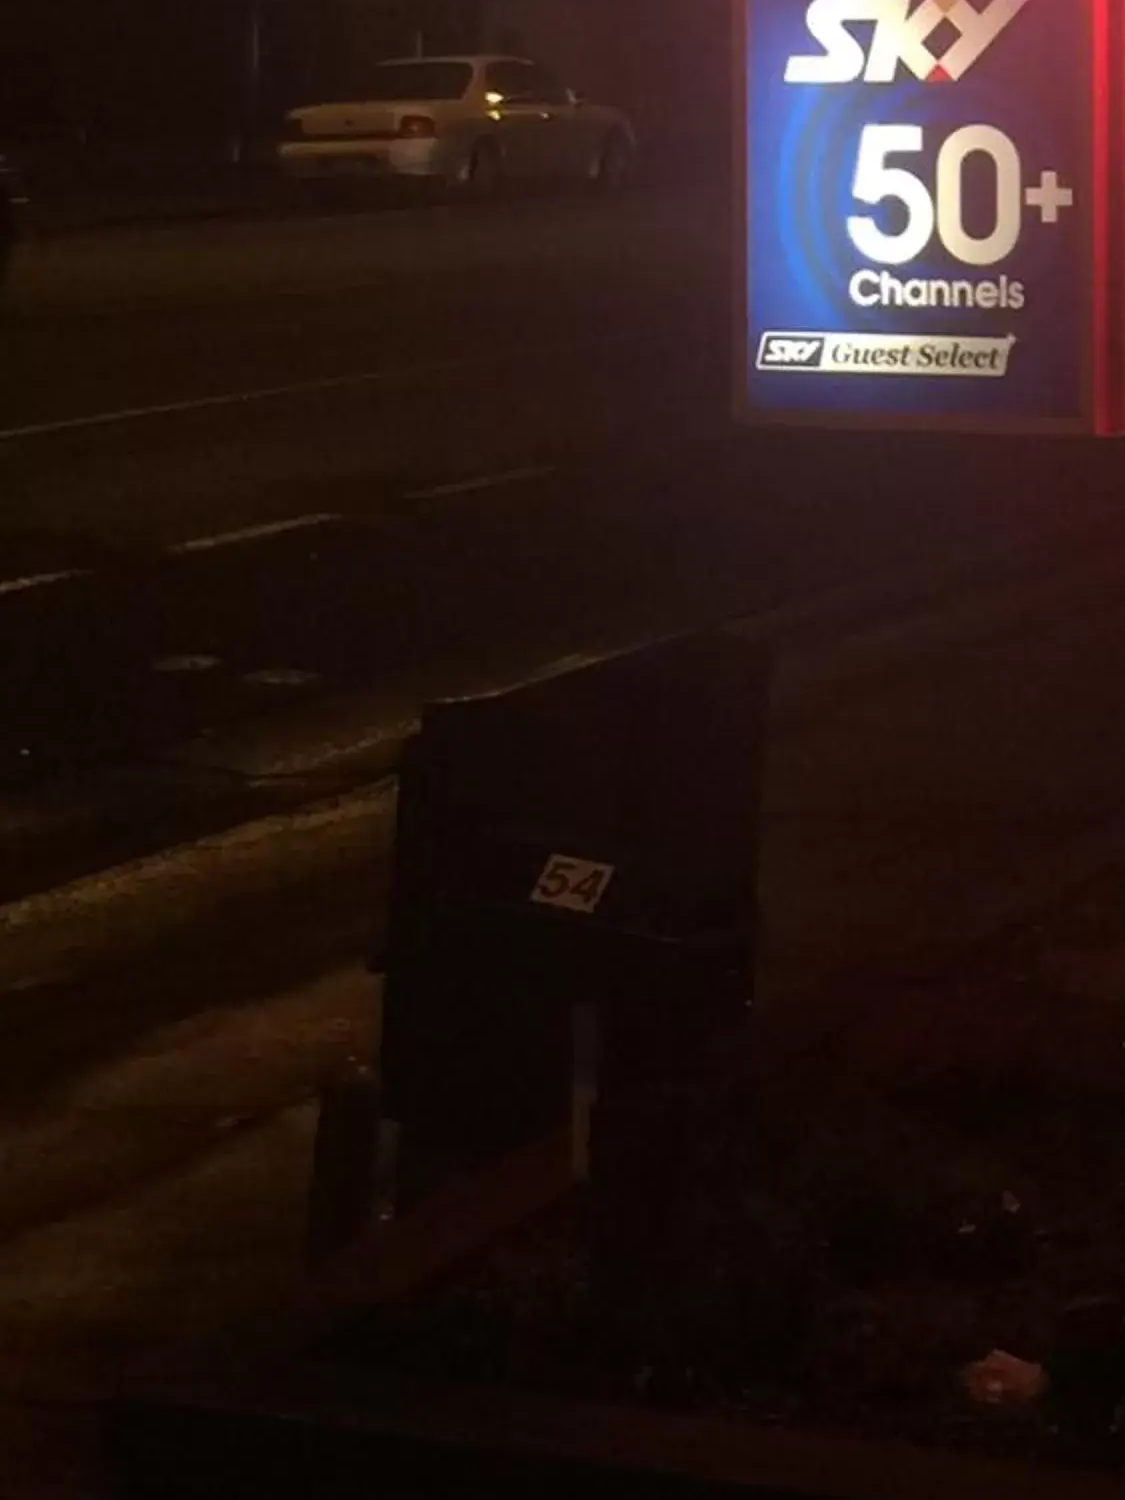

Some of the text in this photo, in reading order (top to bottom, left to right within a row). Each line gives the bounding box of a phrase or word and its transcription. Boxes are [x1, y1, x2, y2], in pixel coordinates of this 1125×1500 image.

[847, 124, 1073, 266] 50+
[848, 269, 1025, 309] Channels
[764, 339, 999, 370] SKY Guest Select
[538, 861, 605, 903] 54
